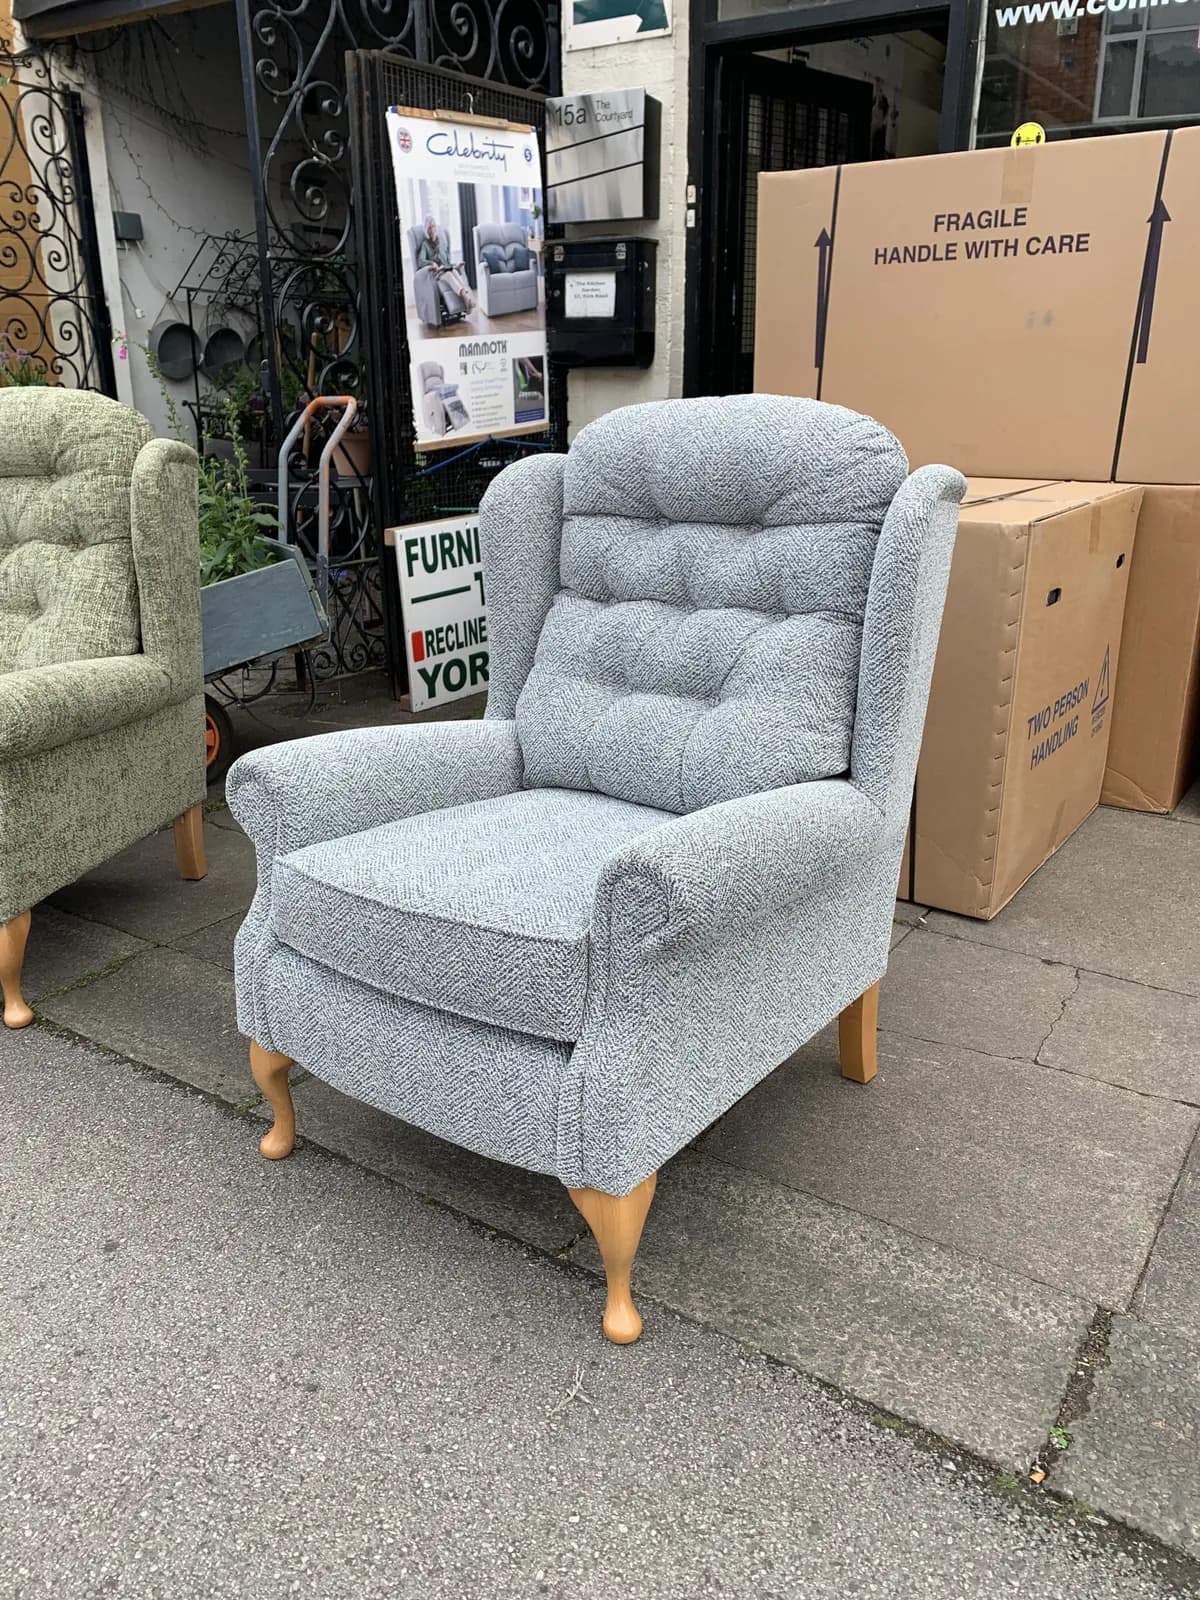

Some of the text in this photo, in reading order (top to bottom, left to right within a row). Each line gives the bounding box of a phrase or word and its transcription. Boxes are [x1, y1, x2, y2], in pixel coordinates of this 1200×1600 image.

[555, 100, 611, 126] 15a The
[594, 110, 633, 123] Courtyard
[426, 129, 514, 172] Celebrity
[934, 207, 1028, 232] FRAGILE
[874, 233, 1090, 265] HANDLE WITH CARE
[459, 341, 507, 357] MAMMOTH
[424, 616, 487, 658] RECLINE
[1027, 705, 1051, 741] TWO
[1052, 677, 1090, 723] PERSON
[1030, 715, 1079, 771] HANDLING
